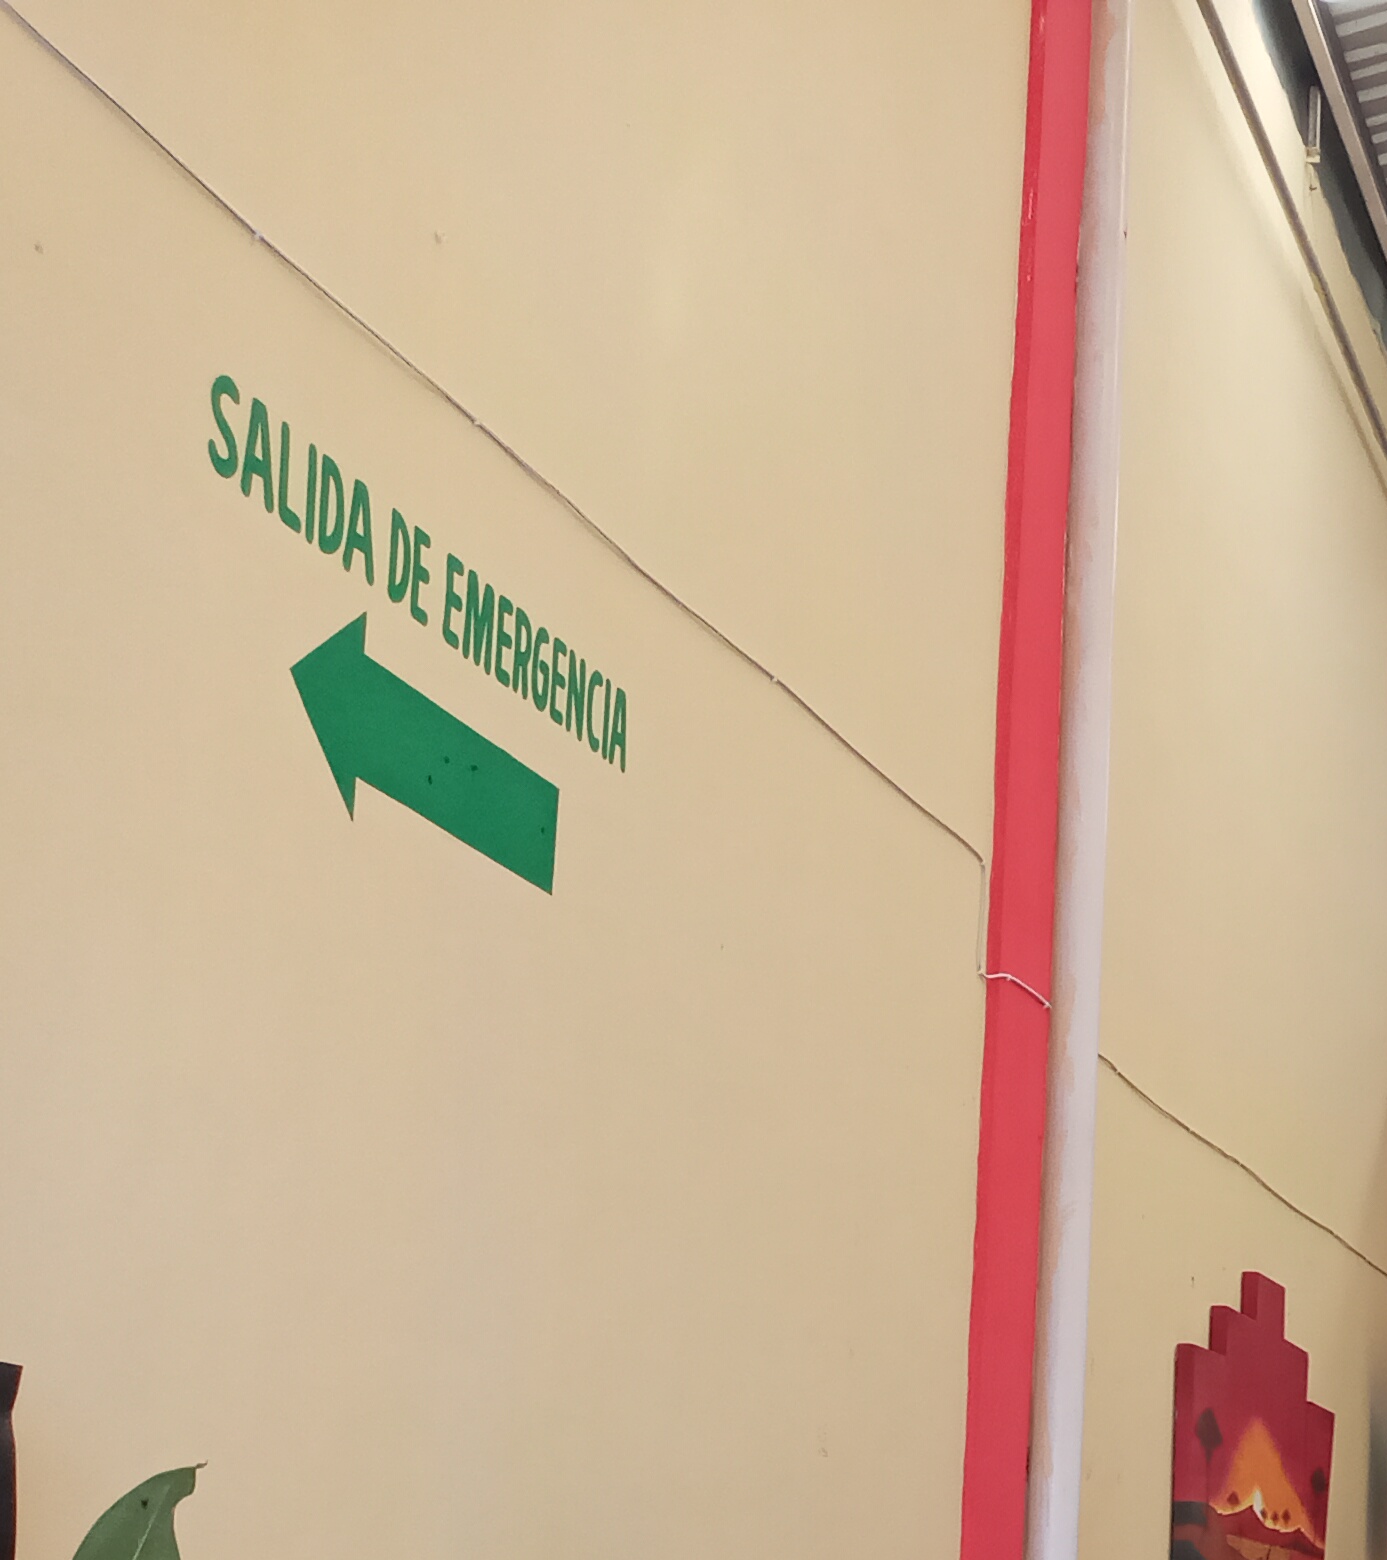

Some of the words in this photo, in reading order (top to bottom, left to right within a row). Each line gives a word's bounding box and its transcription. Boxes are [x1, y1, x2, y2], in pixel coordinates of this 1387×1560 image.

[207, 374, 375, 586] SALIDA
[387, 507, 432, 626] DE
[441, 552, 628, 774] EMERGENCIA
